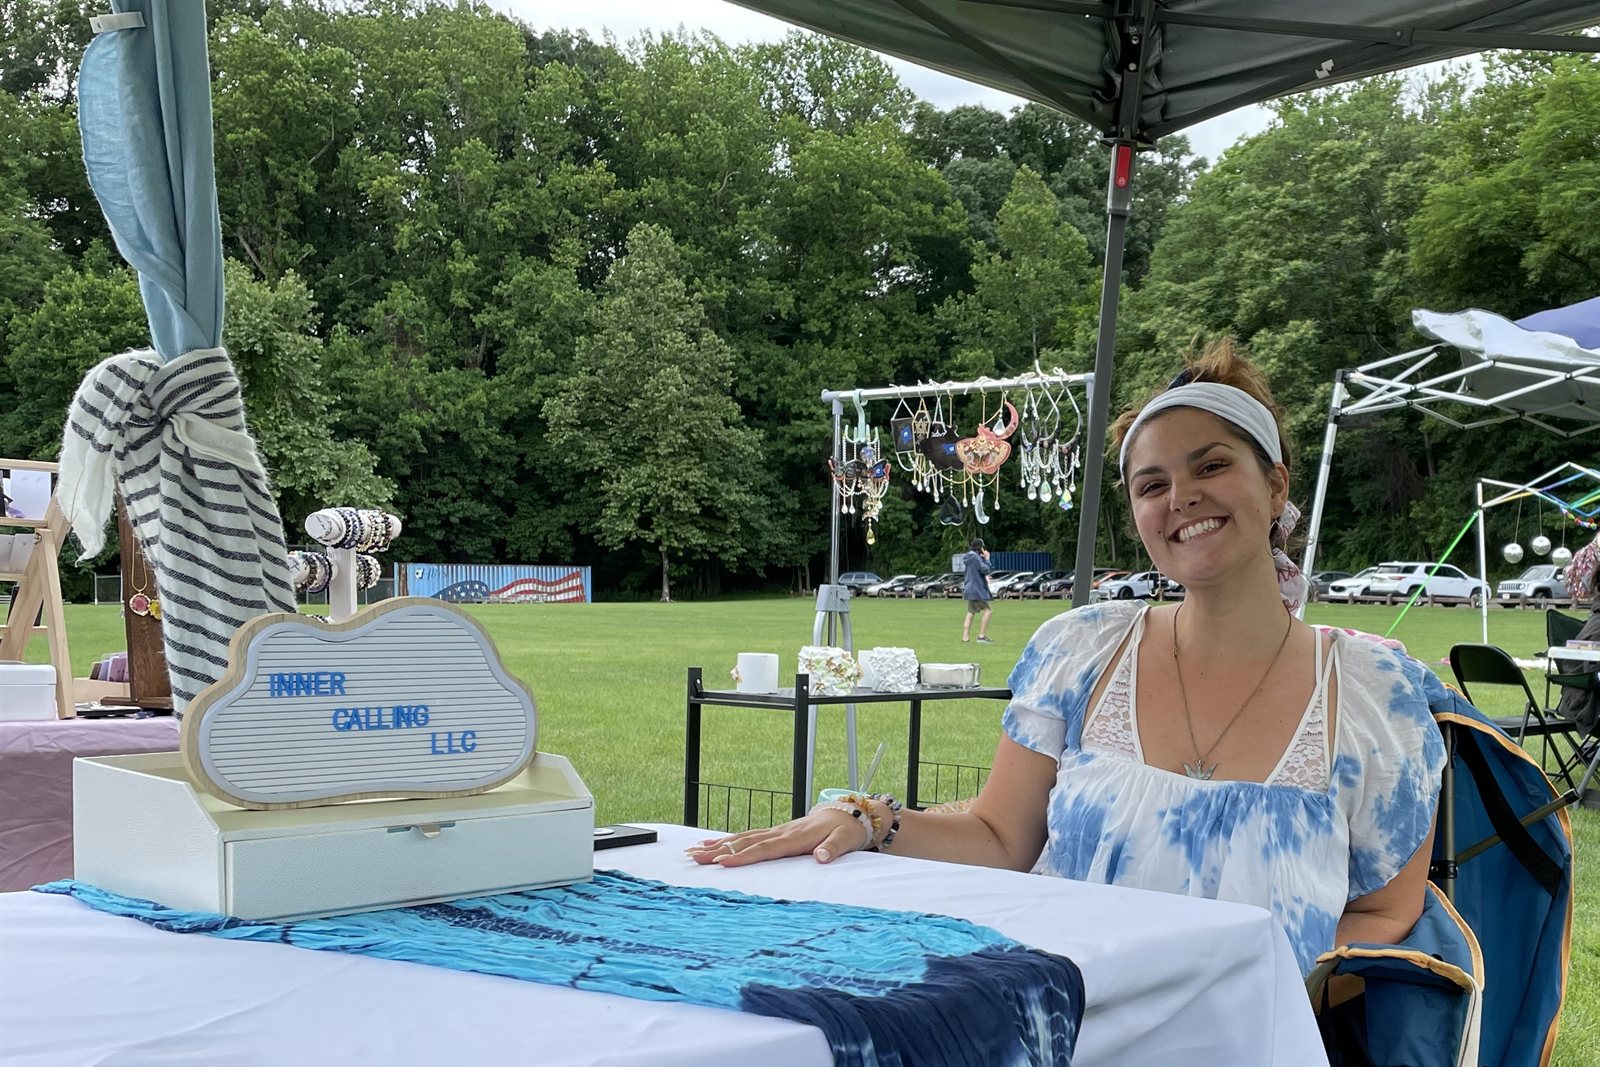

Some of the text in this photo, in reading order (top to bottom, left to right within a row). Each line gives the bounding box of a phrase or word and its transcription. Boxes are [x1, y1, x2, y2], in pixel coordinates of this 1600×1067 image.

[270, 671, 346, 697] INNER
[332, 704, 430, 731] CALLING
[430, 730, 478, 755] LLC
